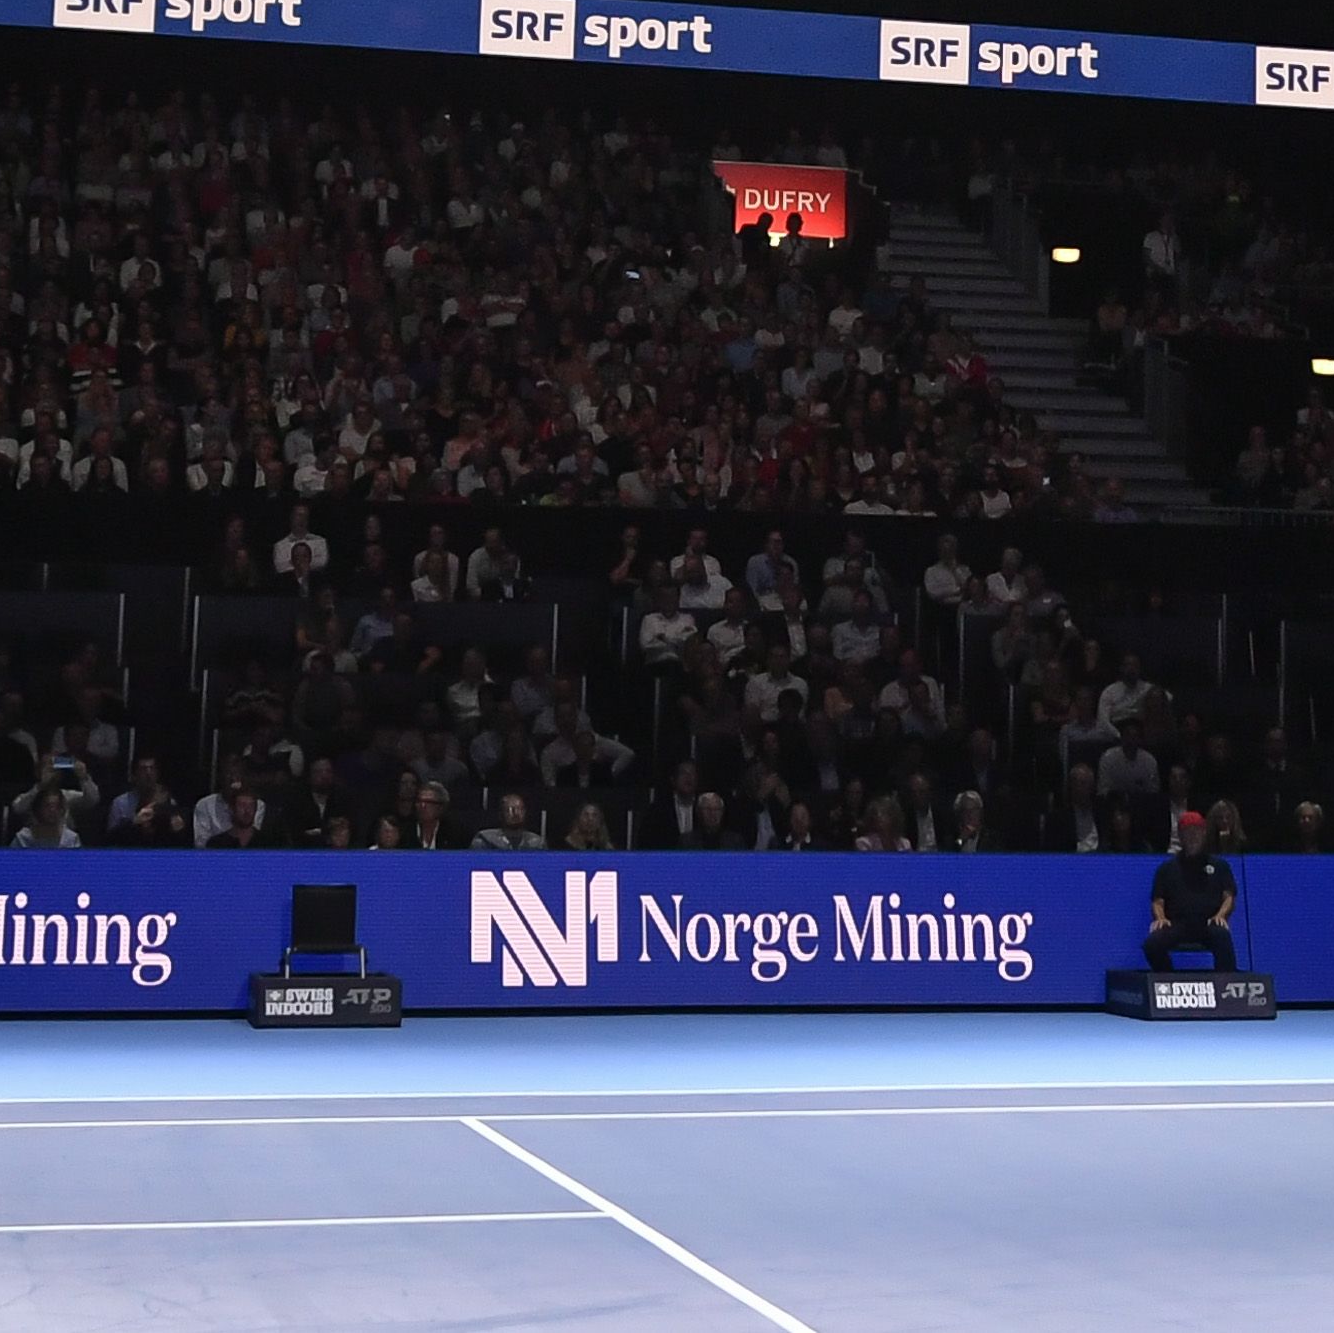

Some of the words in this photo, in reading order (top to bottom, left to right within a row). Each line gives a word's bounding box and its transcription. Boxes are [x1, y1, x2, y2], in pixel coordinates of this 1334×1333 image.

[490, 9, 564, 43] SRF
[584, 12, 712, 58] sport
[889, 36, 959, 68] SRF
[977, 39, 1098, 83] sport
[1265, 62, 1331, 93] SRF
[744, 188, 831, 213] DUFRY
[638, 893, 819, 983] Norge
[833, 891, 1034, 982] Mining
[286, 988, 333, 1001] SWISS
[341, 988, 392, 1004] ATP
[1172, 981, 1215, 995] SWISS
[1221, 982, 1265, 999] ATP
[265, 1002, 334, 1015] INDOORS
